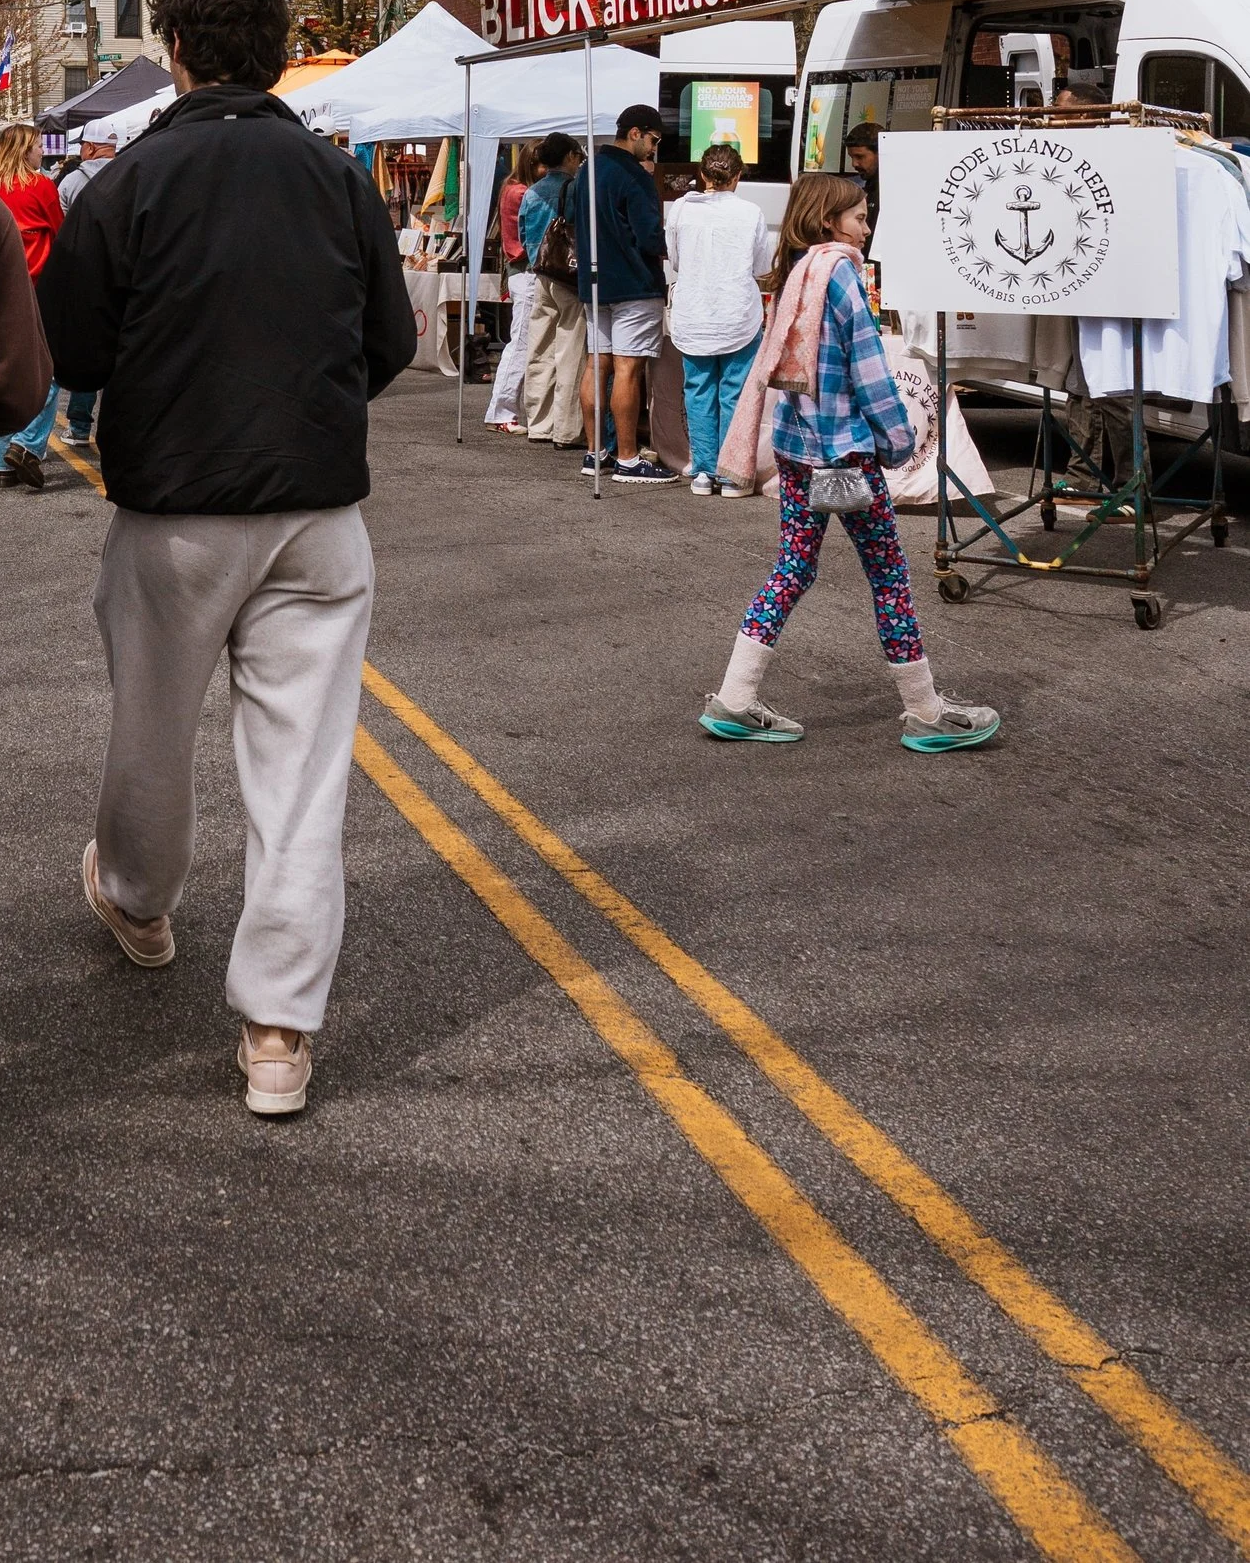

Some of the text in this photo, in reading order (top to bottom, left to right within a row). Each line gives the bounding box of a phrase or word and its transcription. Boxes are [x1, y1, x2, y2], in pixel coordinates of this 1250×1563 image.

[698, 86, 747, 94] NOT YOUR
[936, 138, 1115, 215] RHODE ISLAND REEF
[942, 237, 1110, 305] THE CANNABIS GOLD STANDARD
